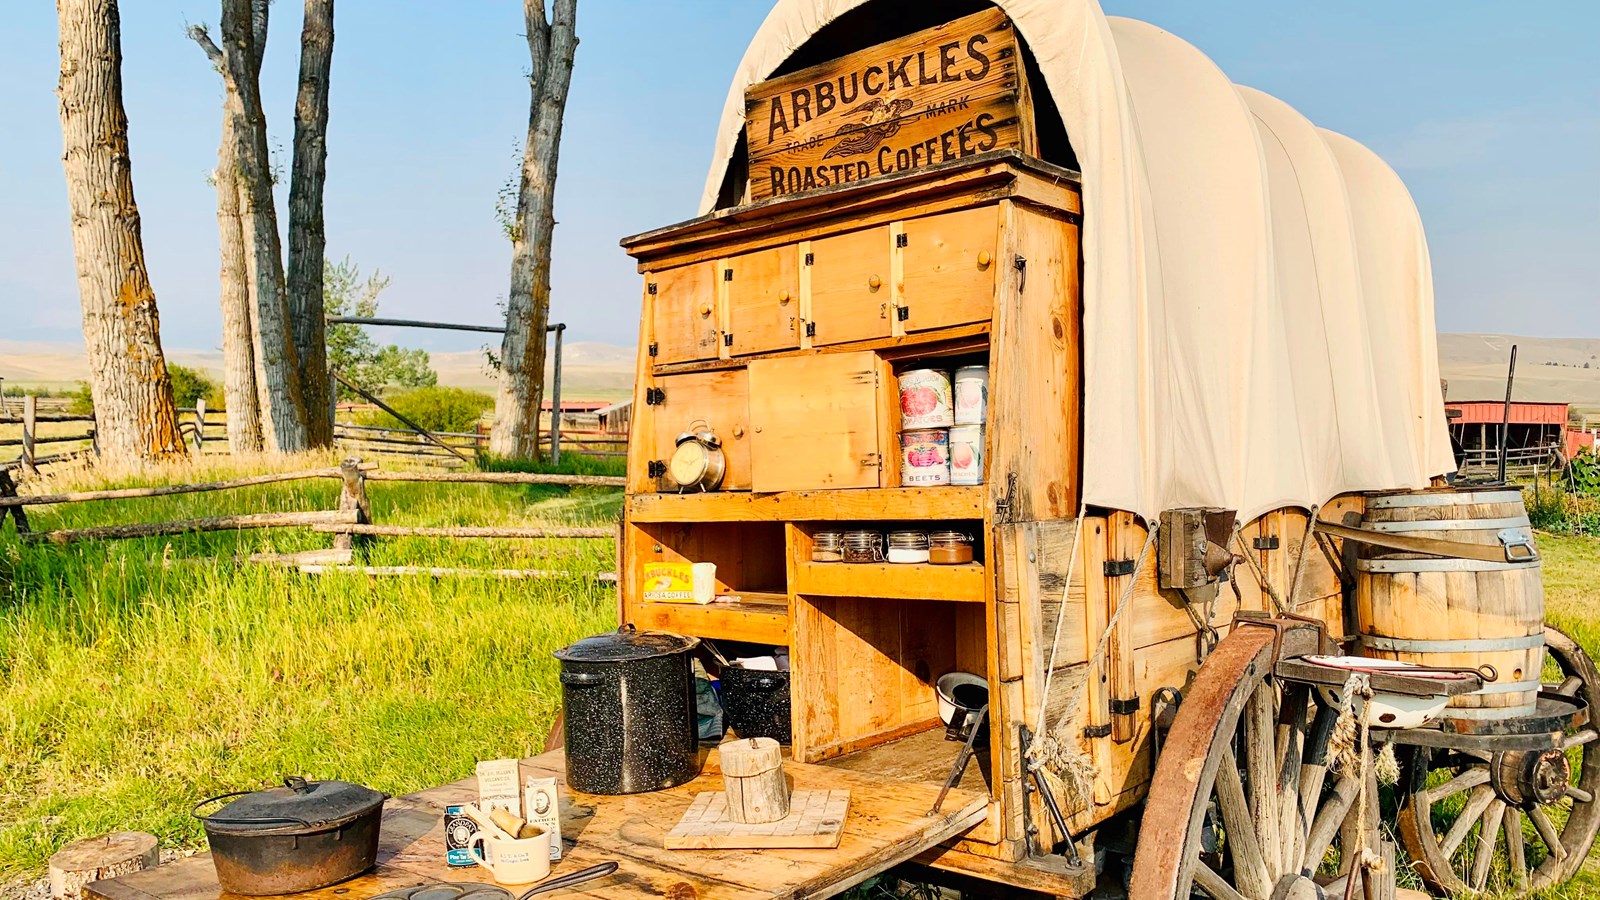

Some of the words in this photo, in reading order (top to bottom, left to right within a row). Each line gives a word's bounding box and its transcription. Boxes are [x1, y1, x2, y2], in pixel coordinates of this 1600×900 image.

[768, 34, 991, 145] ARBUCKLES
[786, 134, 824, 154] TRADE
[925, 95, 970, 119] MARK
[770, 160, 870, 197] ROASTED
[877, 113, 998, 175] COFFEES
[908, 474, 941, 482] BEETS
[668, 591, 690, 599] COFFEE
